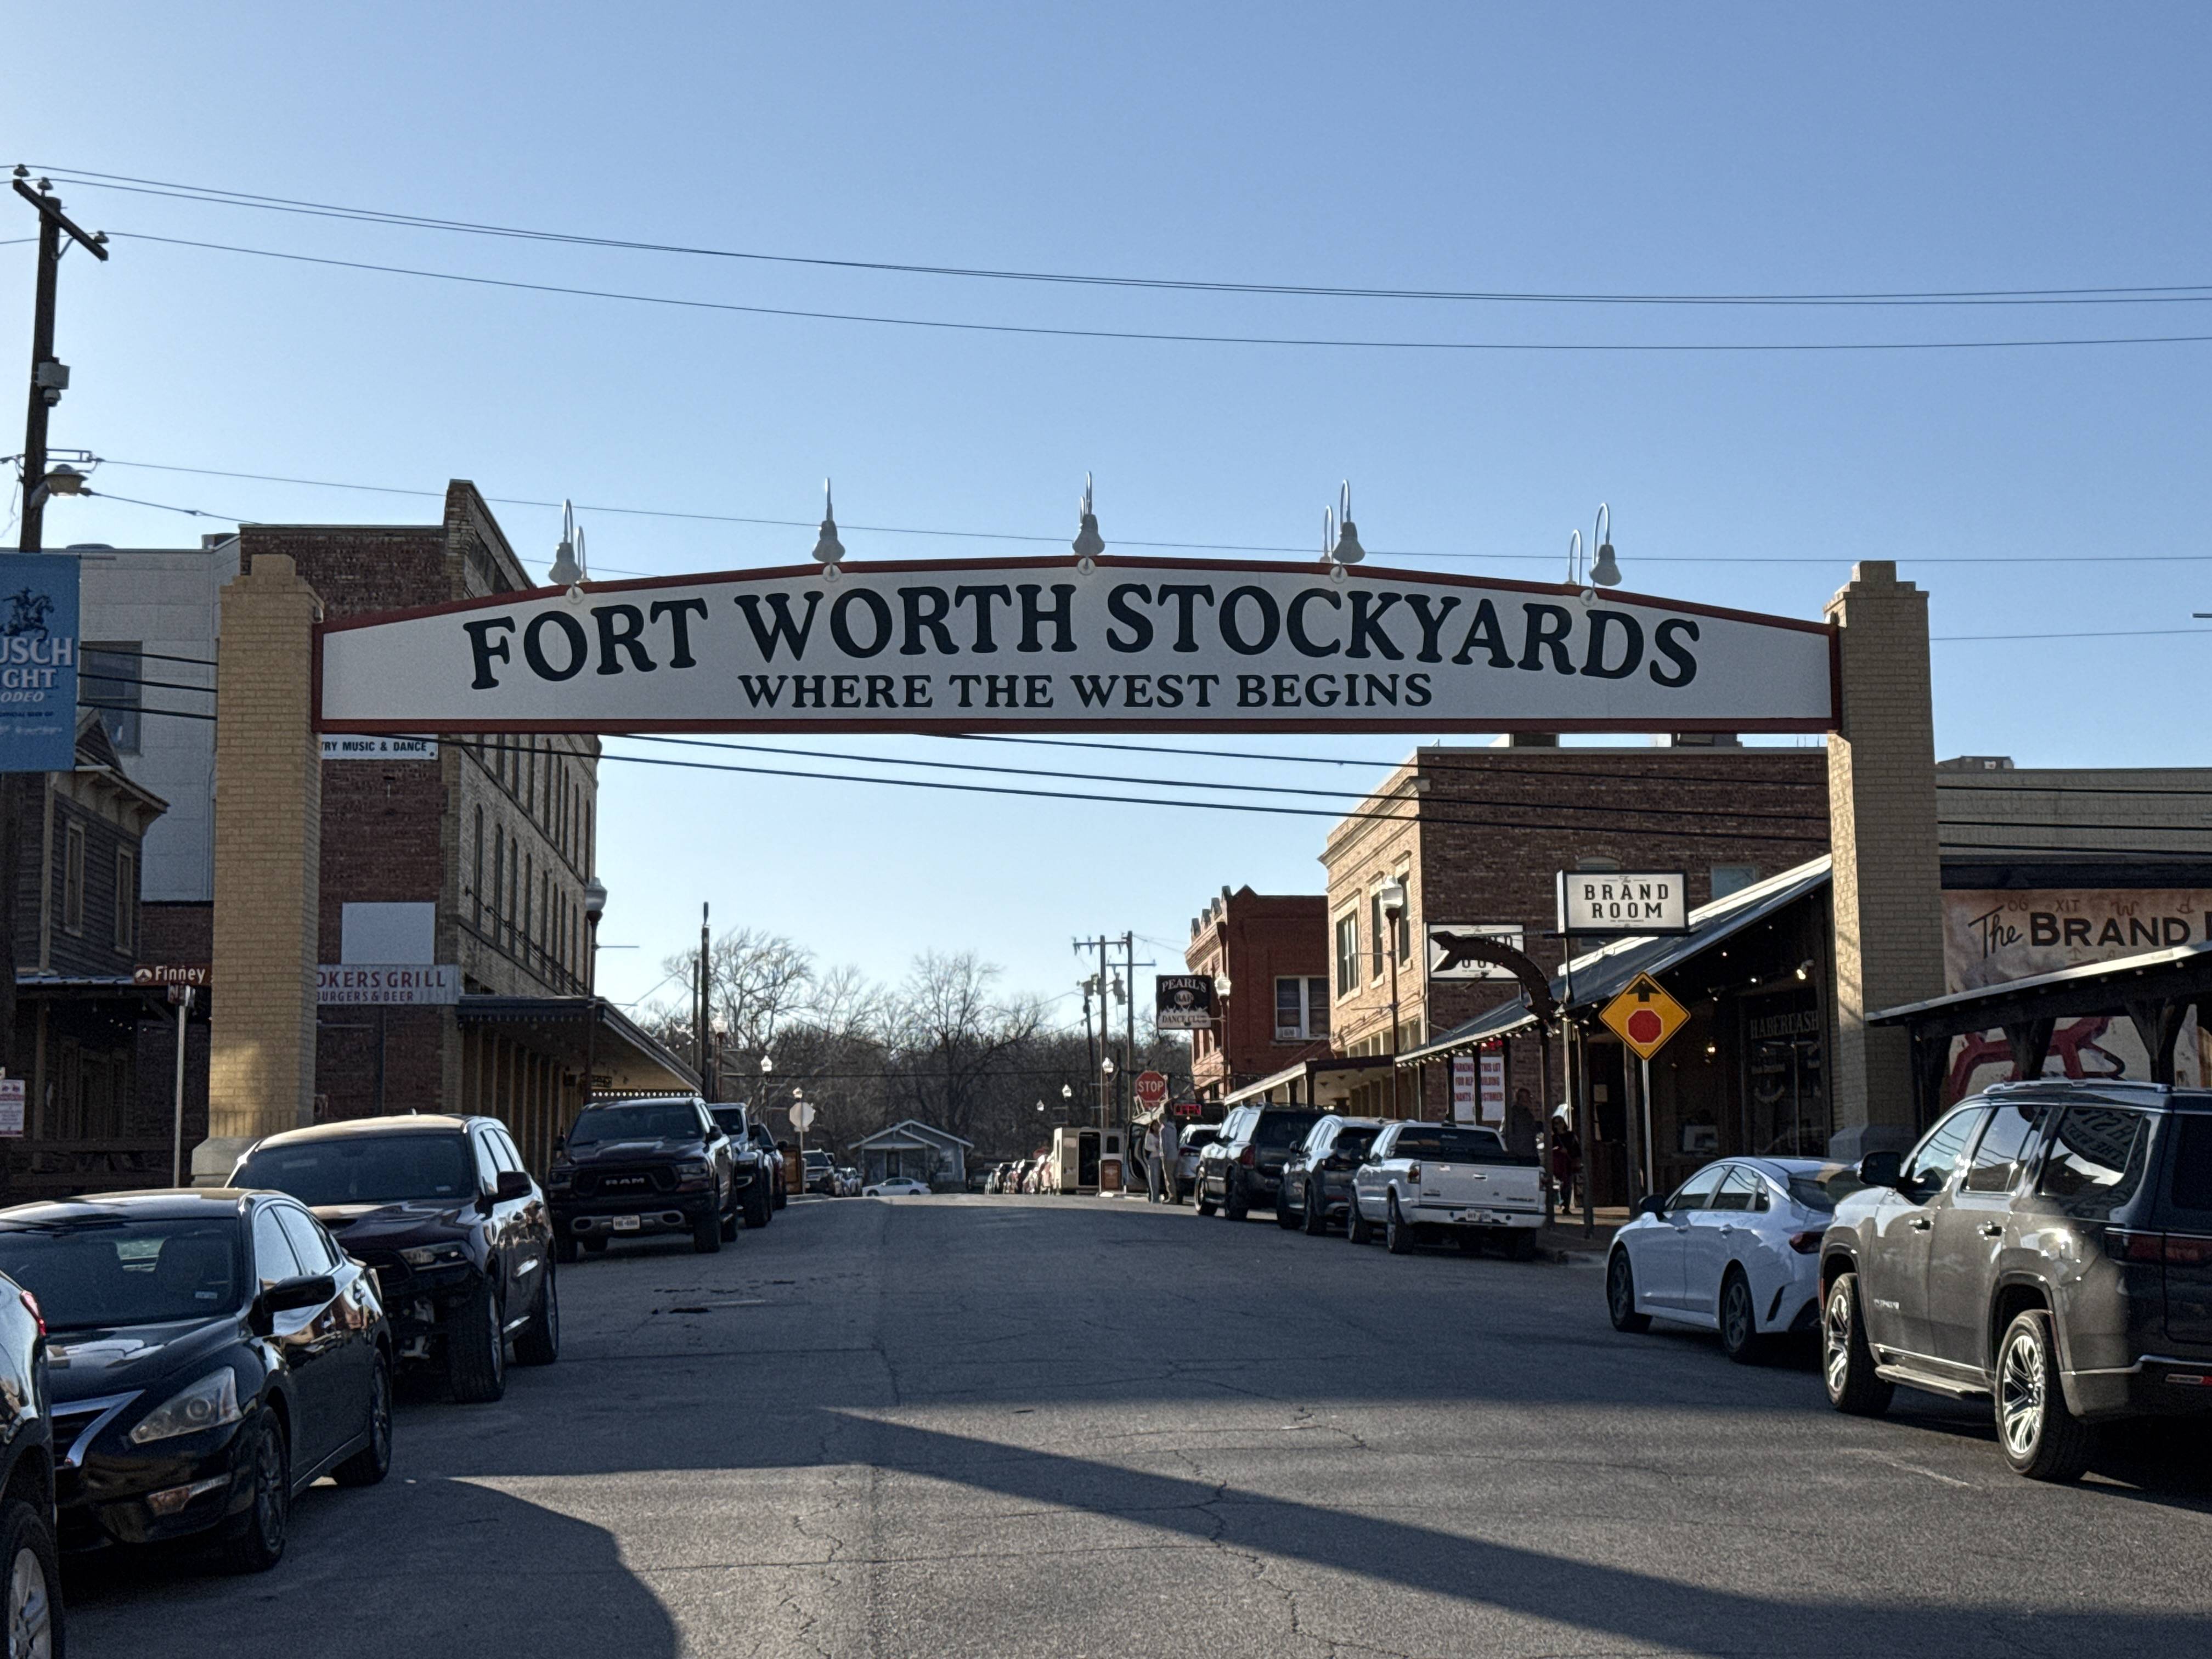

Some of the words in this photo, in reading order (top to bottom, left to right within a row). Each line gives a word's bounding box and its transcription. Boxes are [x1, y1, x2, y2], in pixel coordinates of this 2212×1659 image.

[462, 597, 708, 690] FORT
[734, 584, 1077, 663] WORTH
[1106, 583, 1700, 687] STOCKYARDS
[737, 675, 932, 708] WHERE
[949, 675, 1053, 708] THE
[1070, 674, 1220, 708] WEST
[1236, 673, 1432, 707] BEGINS
[342, 741, 375, 751] MUSIC
[380, 742, 387, 751] &
[393, 741, 427, 752] DANCE
[1584, 884, 1668, 900] BRAND
[1592, 902, 1662, 918] ROOM
[1968, 905, 2023, 959] The
[2030, 912, 2191, 946] BRAND
[155, 966, 206, 984] Finney
[387, 971, 446, 988] GRILL
[1162, 978, 1206, 992] PEARL'S
[371, 991, 379, 1001] &
[384, 991, 414, 1001] BEER
[1138, 1081, 1163, 1093] STOP
